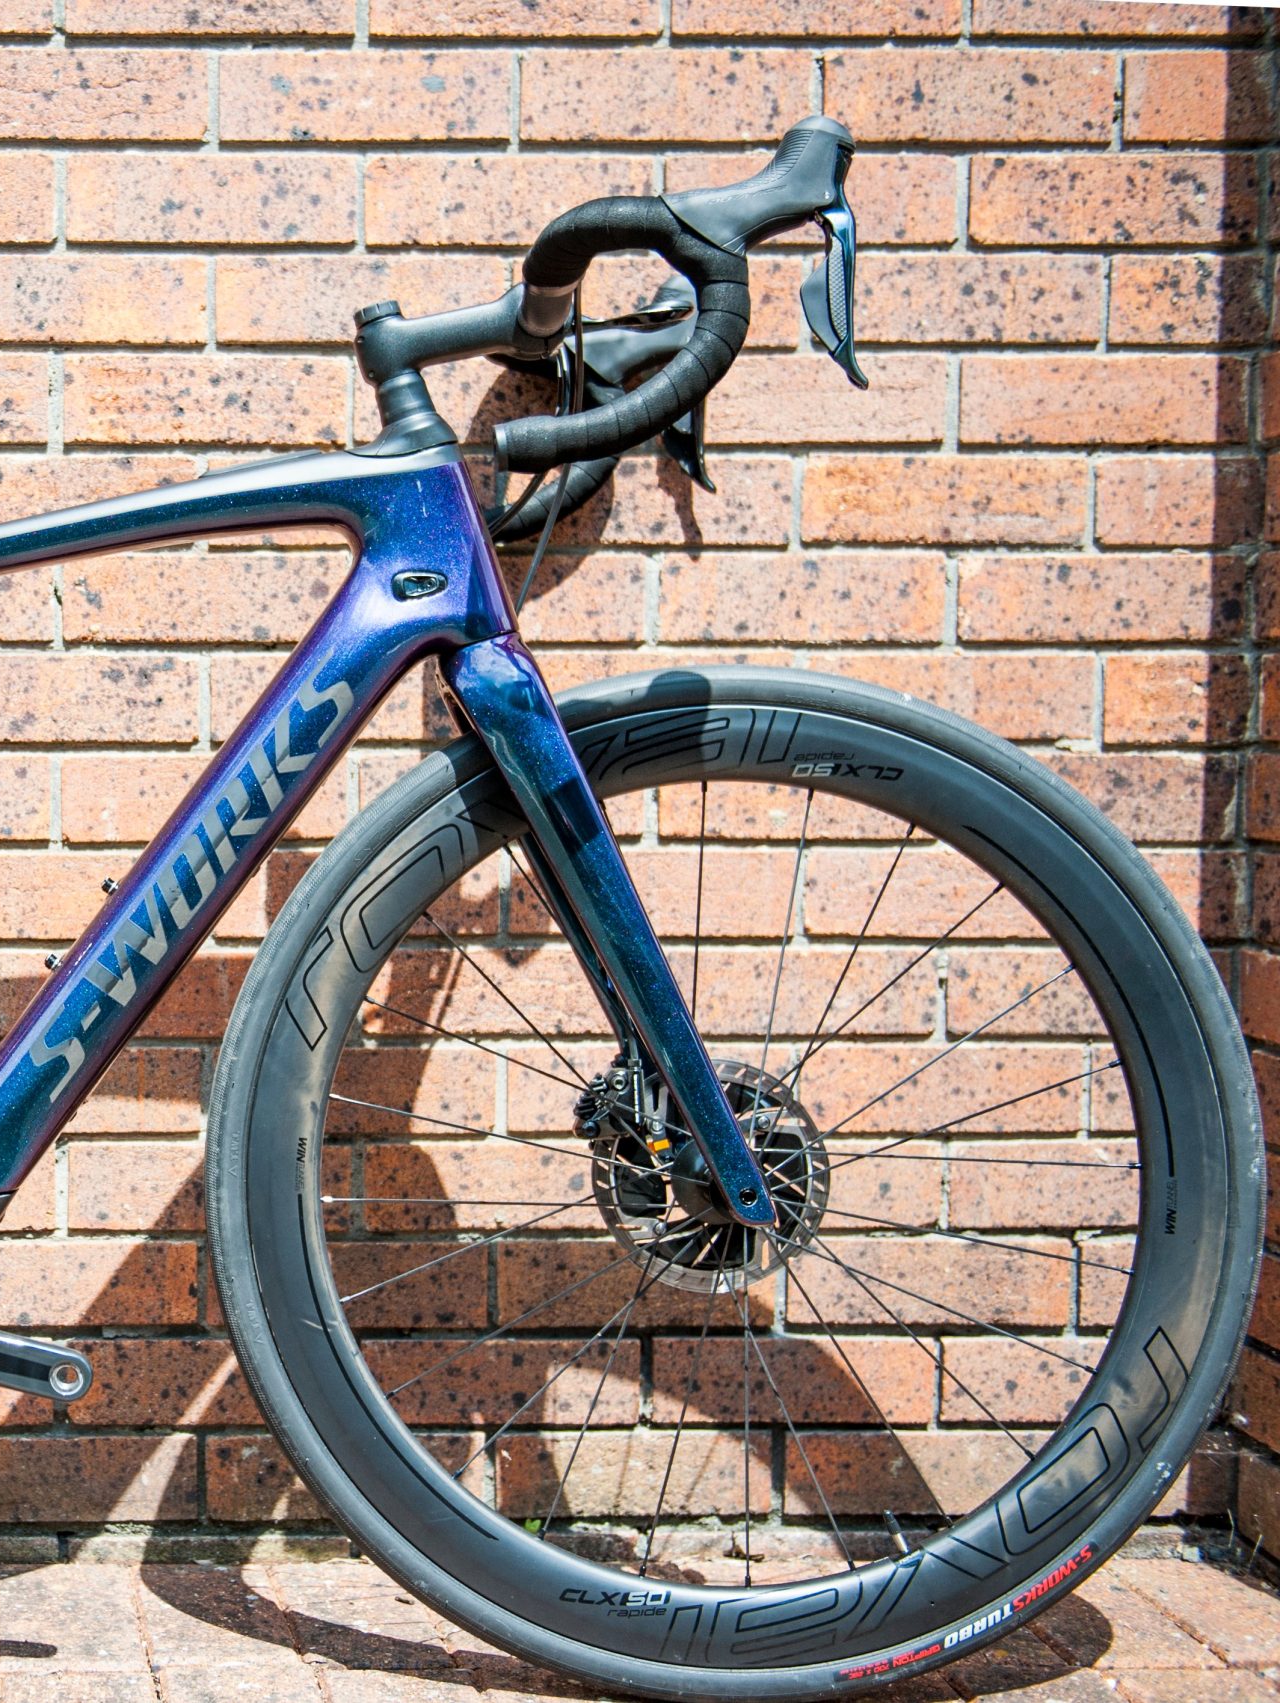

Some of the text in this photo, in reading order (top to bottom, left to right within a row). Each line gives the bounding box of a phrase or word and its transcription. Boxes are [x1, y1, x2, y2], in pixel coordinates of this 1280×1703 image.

[28, 648, 356, 1102] S-WORKS
[1013, 1544, 1092, 1612] S-WORKS
[607, 1606, 668, 1619] rapide
[944, 1602, 1014, 1649] TURBO
